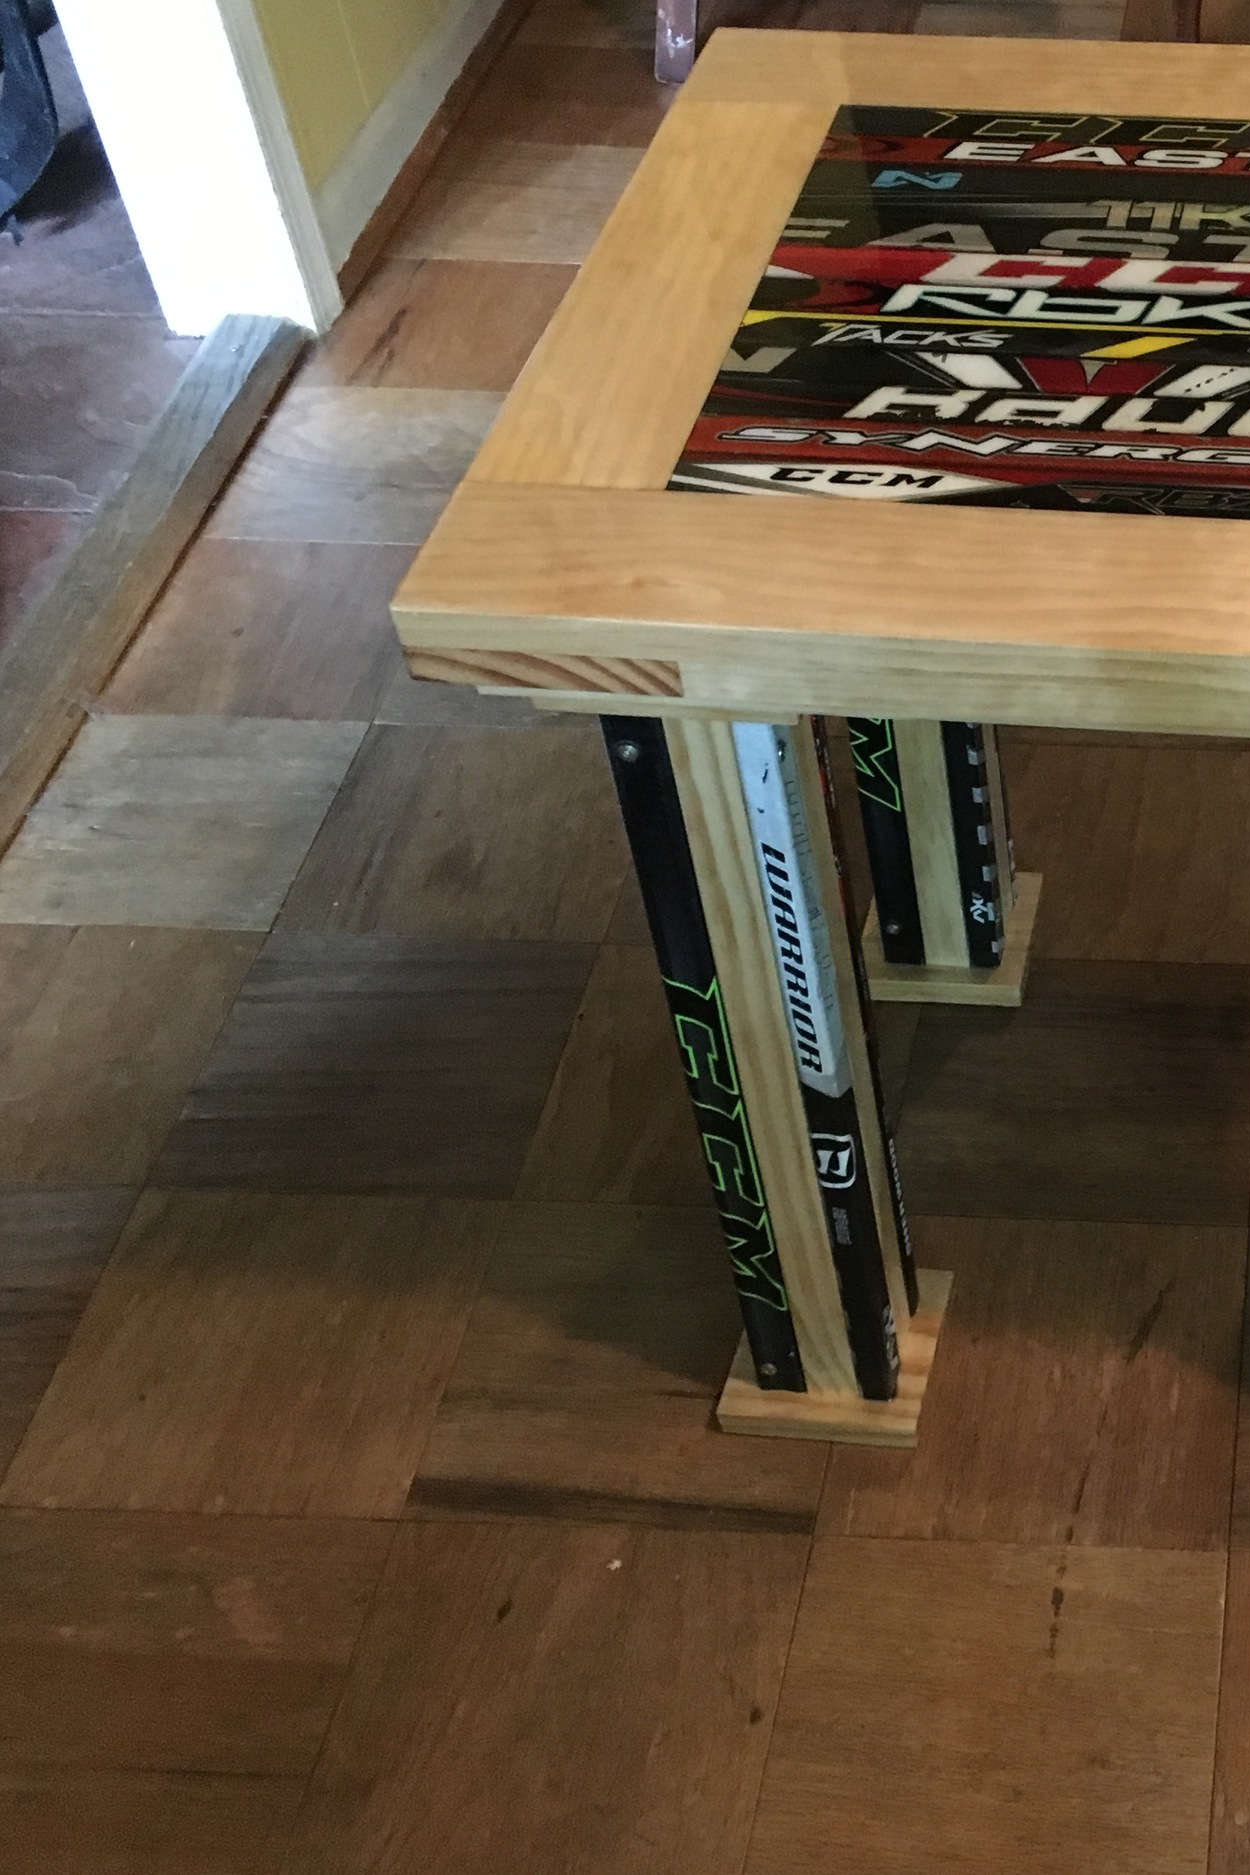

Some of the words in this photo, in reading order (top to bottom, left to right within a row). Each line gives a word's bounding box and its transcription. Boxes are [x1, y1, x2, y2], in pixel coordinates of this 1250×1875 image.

[811, 322, 1014, 349] TACKS
[769, 467, 945, 488] CCM
[760, 841, 823, 1074] WARRIOR
